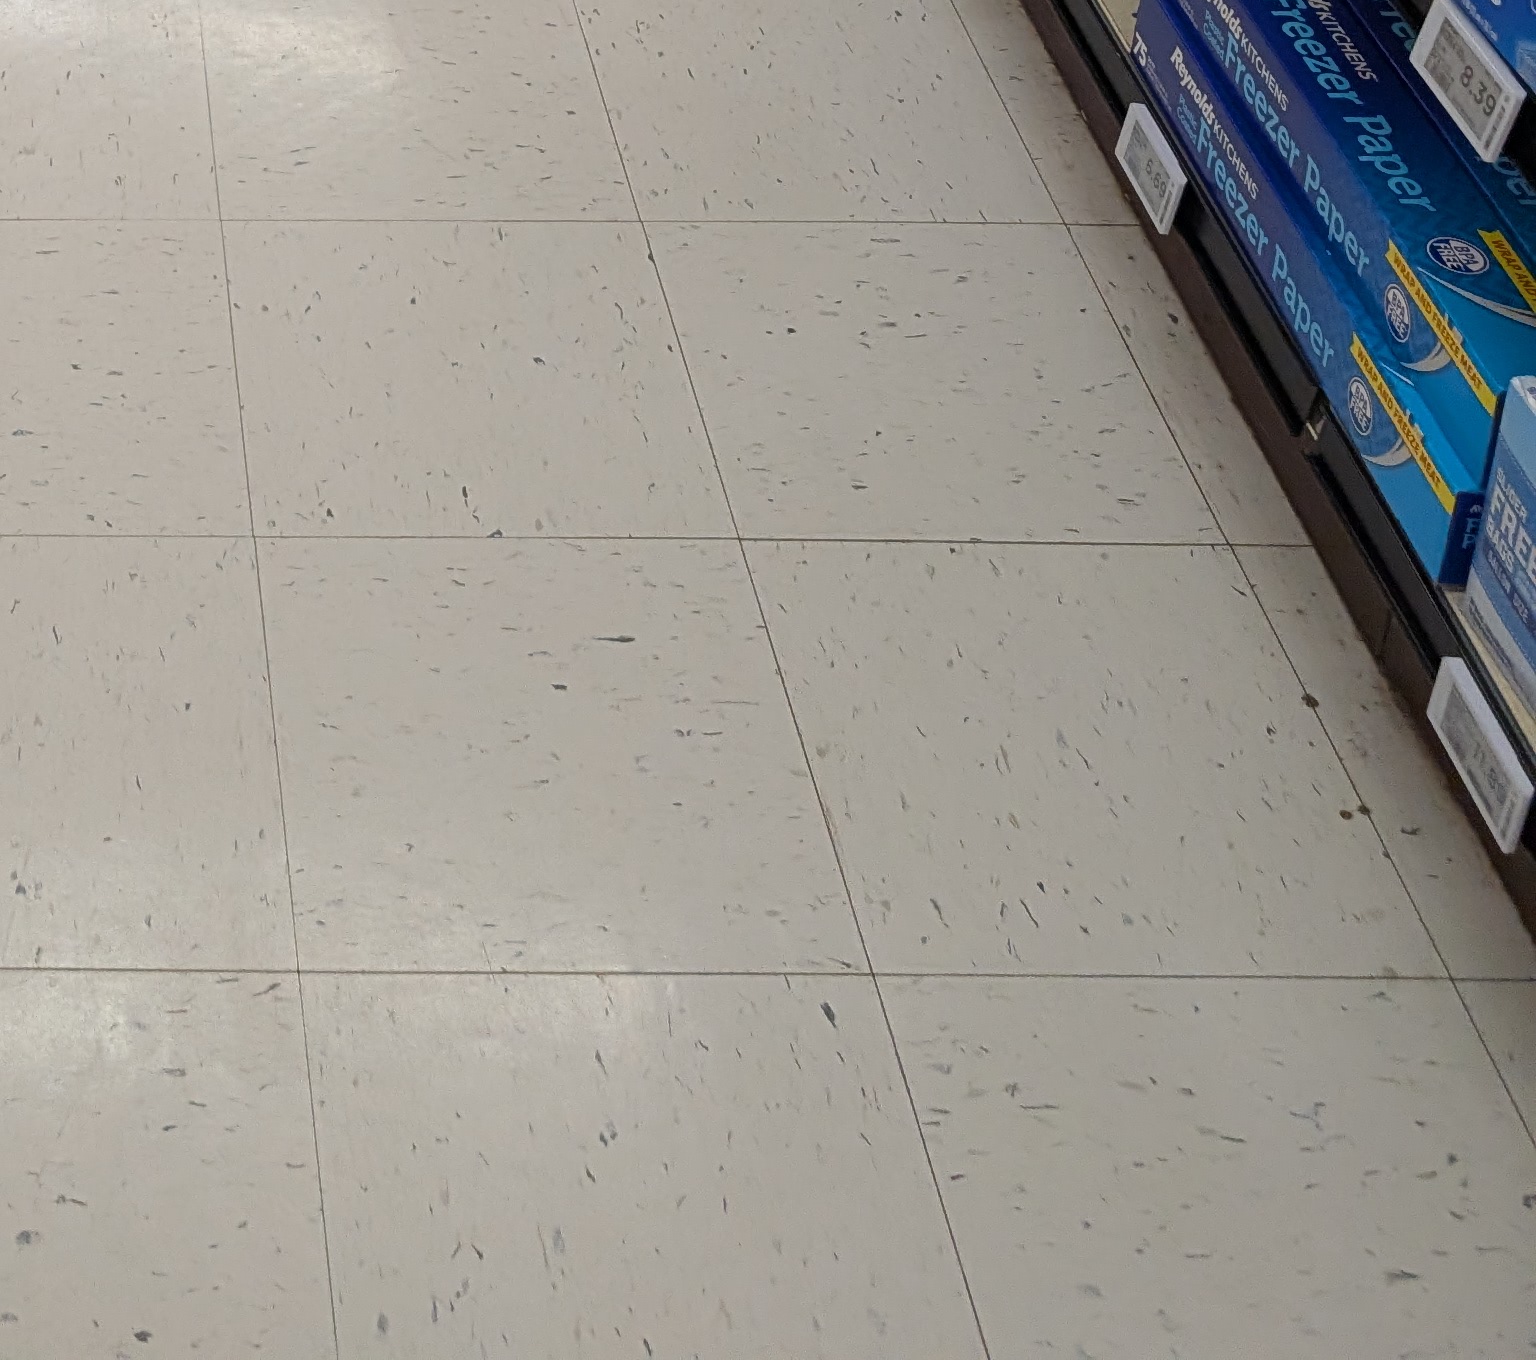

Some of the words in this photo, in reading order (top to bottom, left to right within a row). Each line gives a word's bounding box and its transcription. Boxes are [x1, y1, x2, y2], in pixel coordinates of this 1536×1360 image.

[1315, 7, 1379, 83] KITCHENS
[1170, 46, 1215, 125] Reynolds
[1212, 121, 1260, 201] KITCHENS
[1176, 106, 1198, 145] Coated
[1178, 94, 1198, 132] Plastic
[1460, 64, 1497, 118] 8.39
[1223, 31, 1302, 169] Freezer
[1303, 153, 1370, 277] Paper
[1342, 115, 1438, 213] Paper
[1196, 118, 1270, 257] Freezer
[1271, 243, 1335, 368] Paper
[1455, 245, 1480, 268] BPA
[1392, 252, 1416, 288] WRAP
[1413, 287, 1433, 321] AND
[1430, 314, 1462, 360] FREEZE
[1459, 356, 1483, 390] MEAT
[1485, 518, 1516, 570] BAGS
